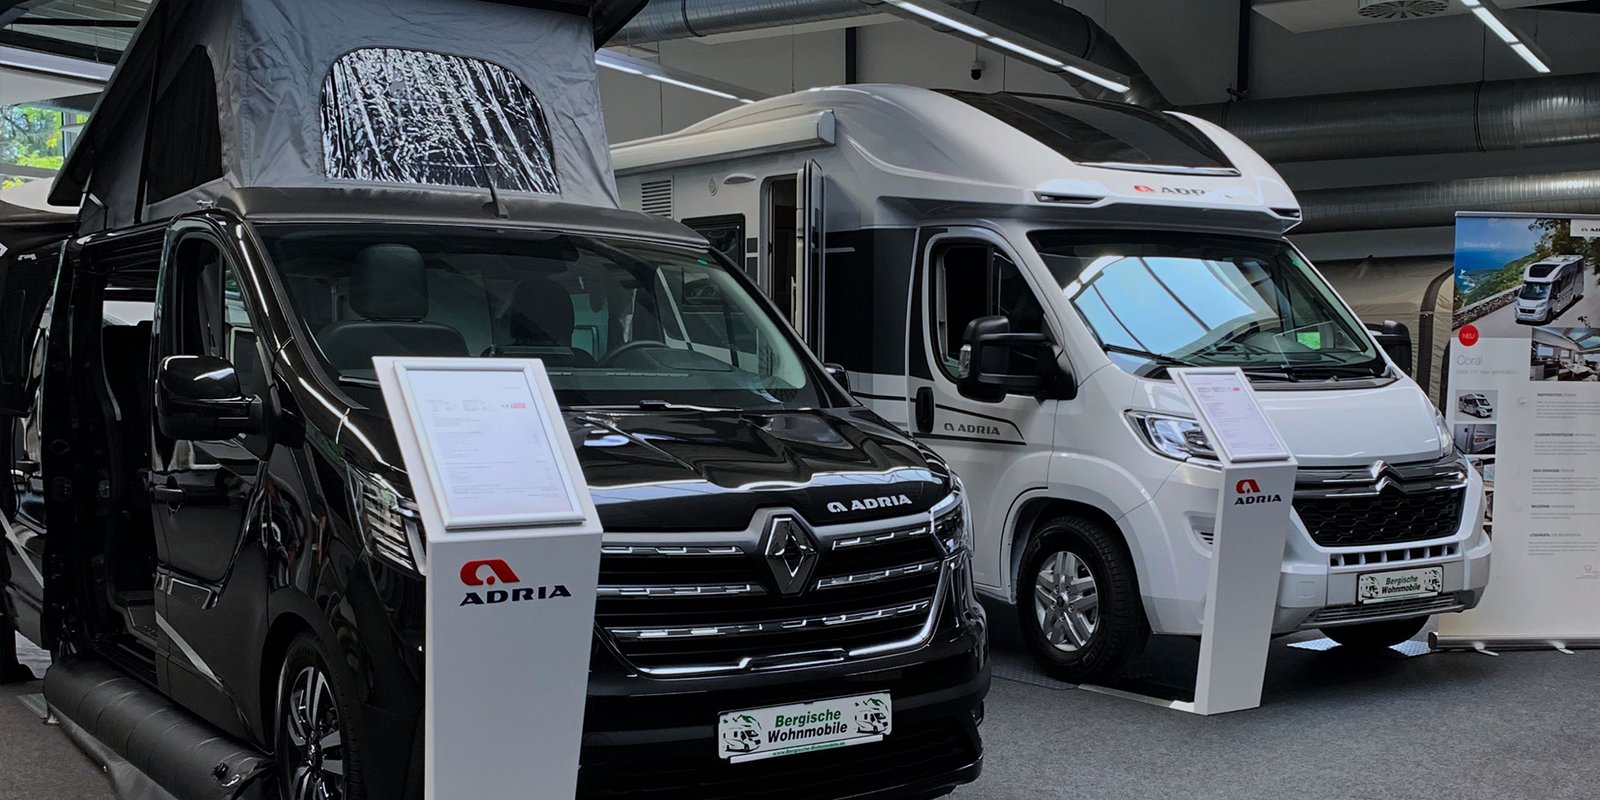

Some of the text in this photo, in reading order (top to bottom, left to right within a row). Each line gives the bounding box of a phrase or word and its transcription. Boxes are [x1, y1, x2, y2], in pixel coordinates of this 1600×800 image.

[1462, 332, 1476, 340] NEU
[1456, 354, 1483, 366] Coral
[957, 424, 1001, 436] ADRIA
[851, 494, 913, 511] ADRIA
[1234, 494, 1282, 506] ADRIA
[1385, 575, 1419, 586] Bergische
[1381, 582, 1421, 594] Wohnmobile
[459, 584, 573, 607] ADRIA
[775, 709, 842, 729] Bergische
[767, 721, 848, 744] Wohnmobile
